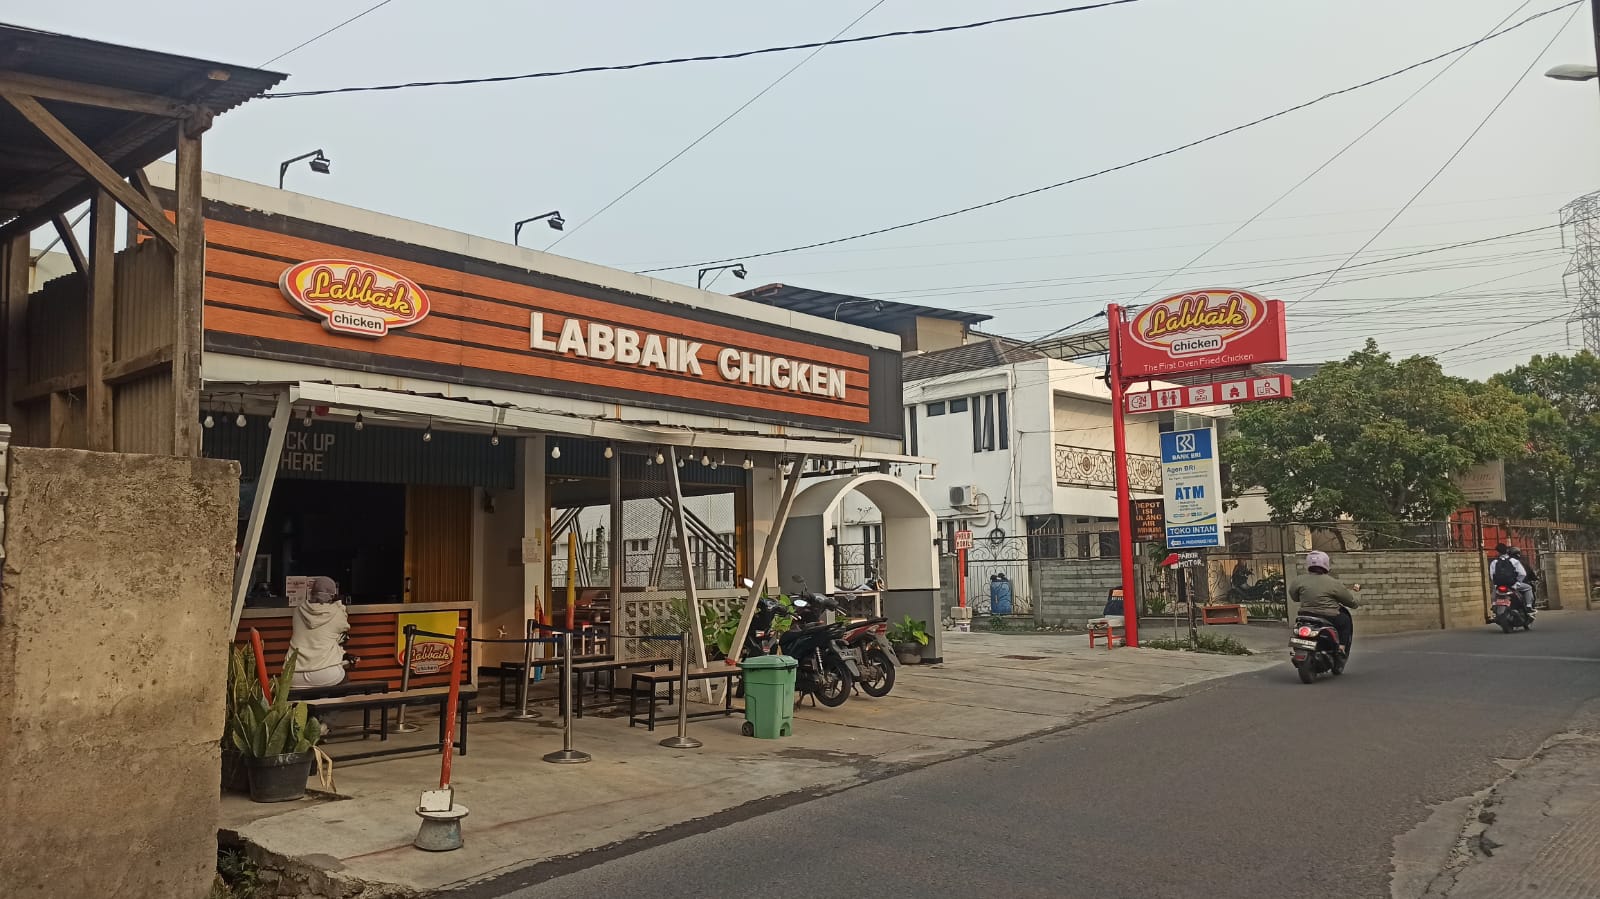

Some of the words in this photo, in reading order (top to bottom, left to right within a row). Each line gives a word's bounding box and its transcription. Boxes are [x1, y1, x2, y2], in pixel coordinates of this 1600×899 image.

[306, 269, 413, 316] Labbaik
[334, 313, 382, 330] chicken
[1146, 295, 1247, 339] Labbaik
[1174, 338, 1218, 351] chicken
[530, 312, 703, 376] LABBAIK
[717, 348, 846, 399] CHICKEN
[1143, 364, 1158, 372] The
[1159, 362, 1177, 370] First
[1177, 359, 1199, 368] Oven
[1200, 356, 1220, 365] Fried
[1221, 353, 1254, 363] Chicken
[286, 431, 308, 450] CK
[313, 432, 336, 452] UP
[280, 451, 324, 472] HERE
[1175, 485, 1204, 500] ATM
[1169, 527, 1191, 535] TOKO
[1192, 526, 1215, 534] INTAN
